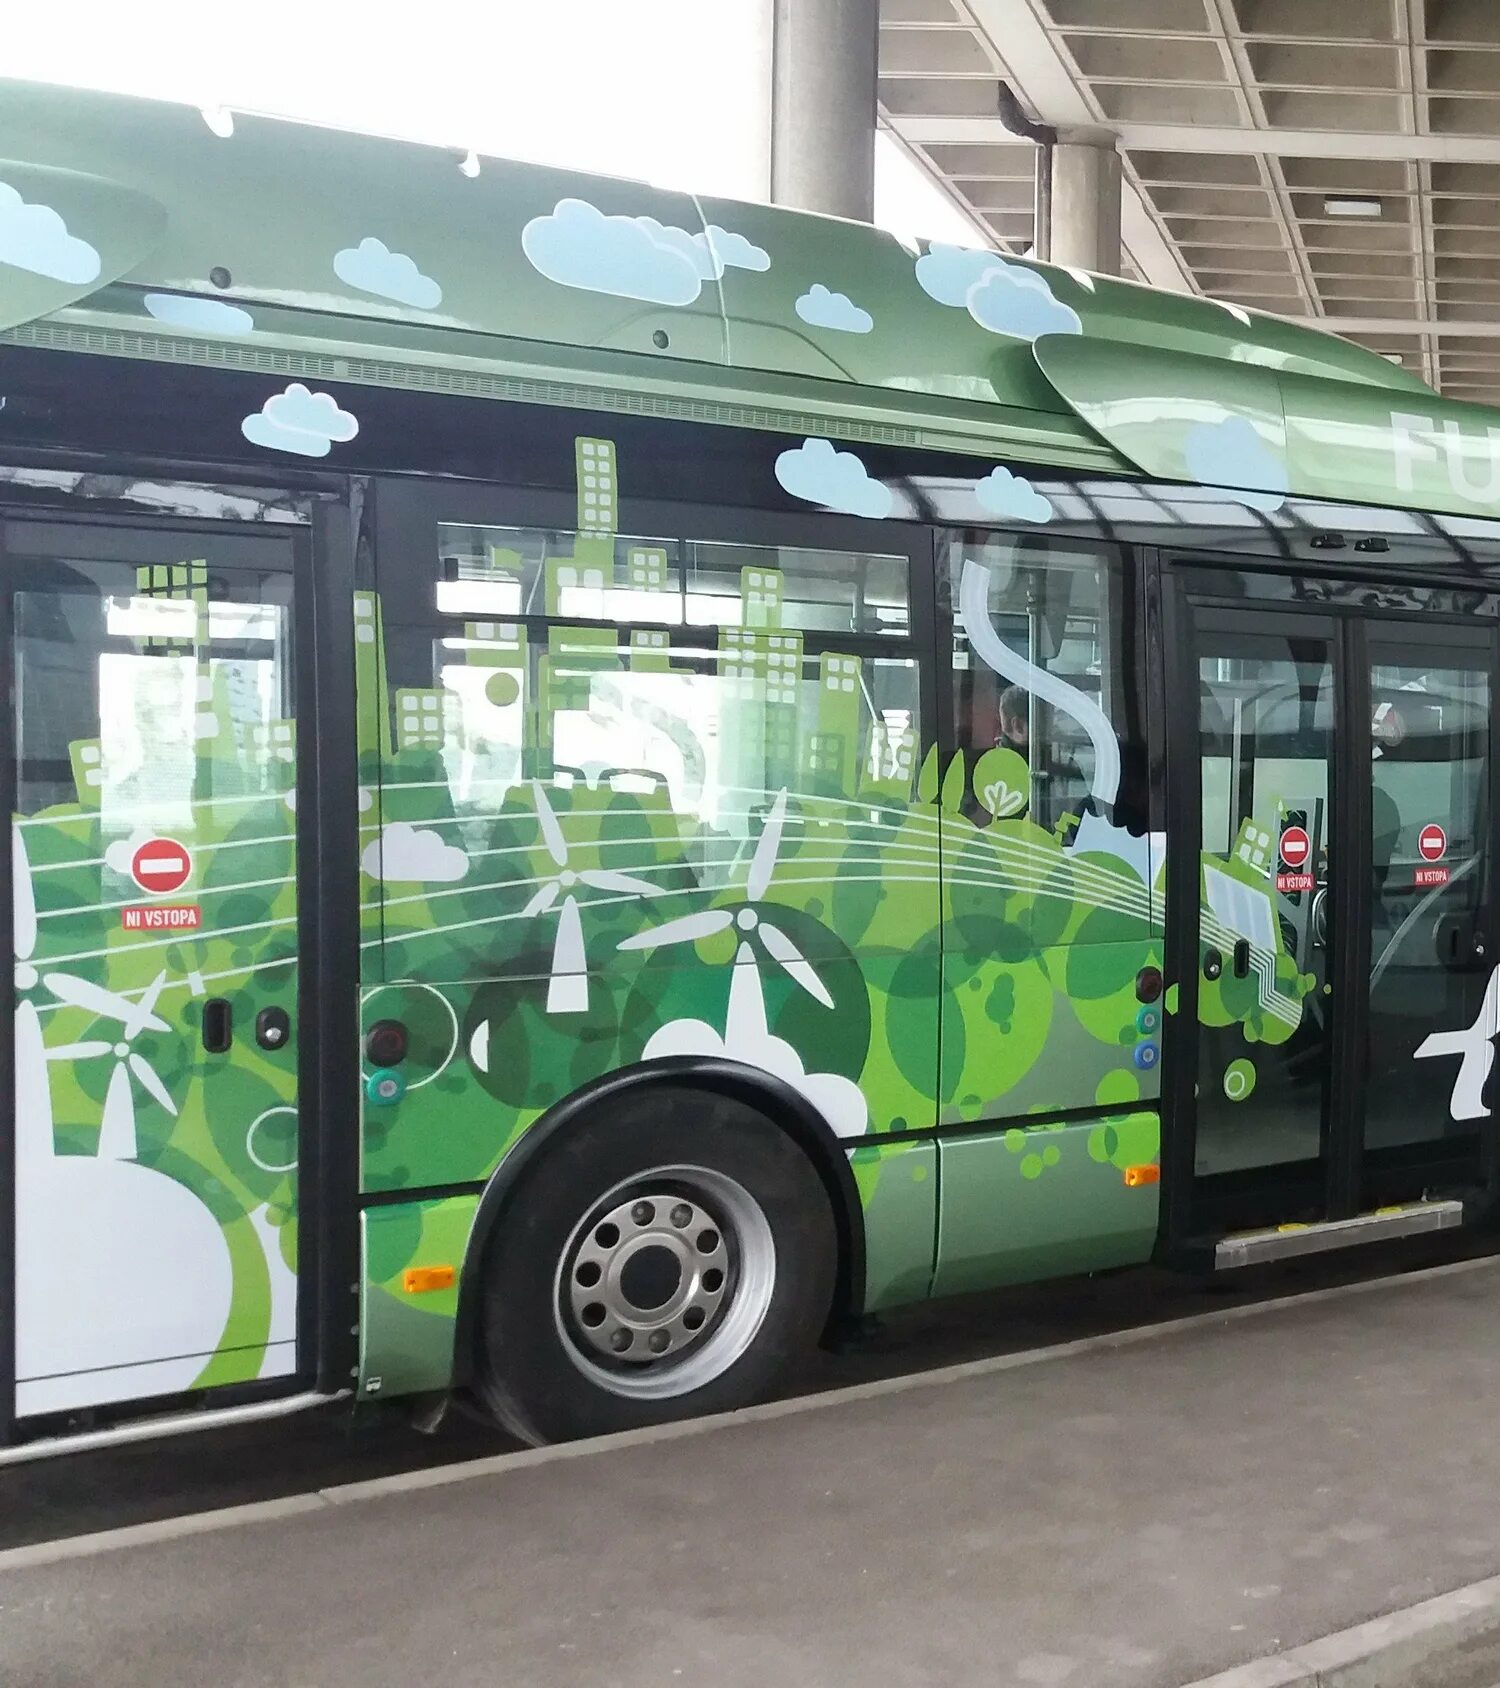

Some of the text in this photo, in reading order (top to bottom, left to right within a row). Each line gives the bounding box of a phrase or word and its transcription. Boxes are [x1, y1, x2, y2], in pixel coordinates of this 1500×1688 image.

[1416, 870, 1447, 882] NI VSTOPA
[1277, 877, 1312, 889] NI VSTOPA
[126, 908, 197, 927] NI VSTOPA
